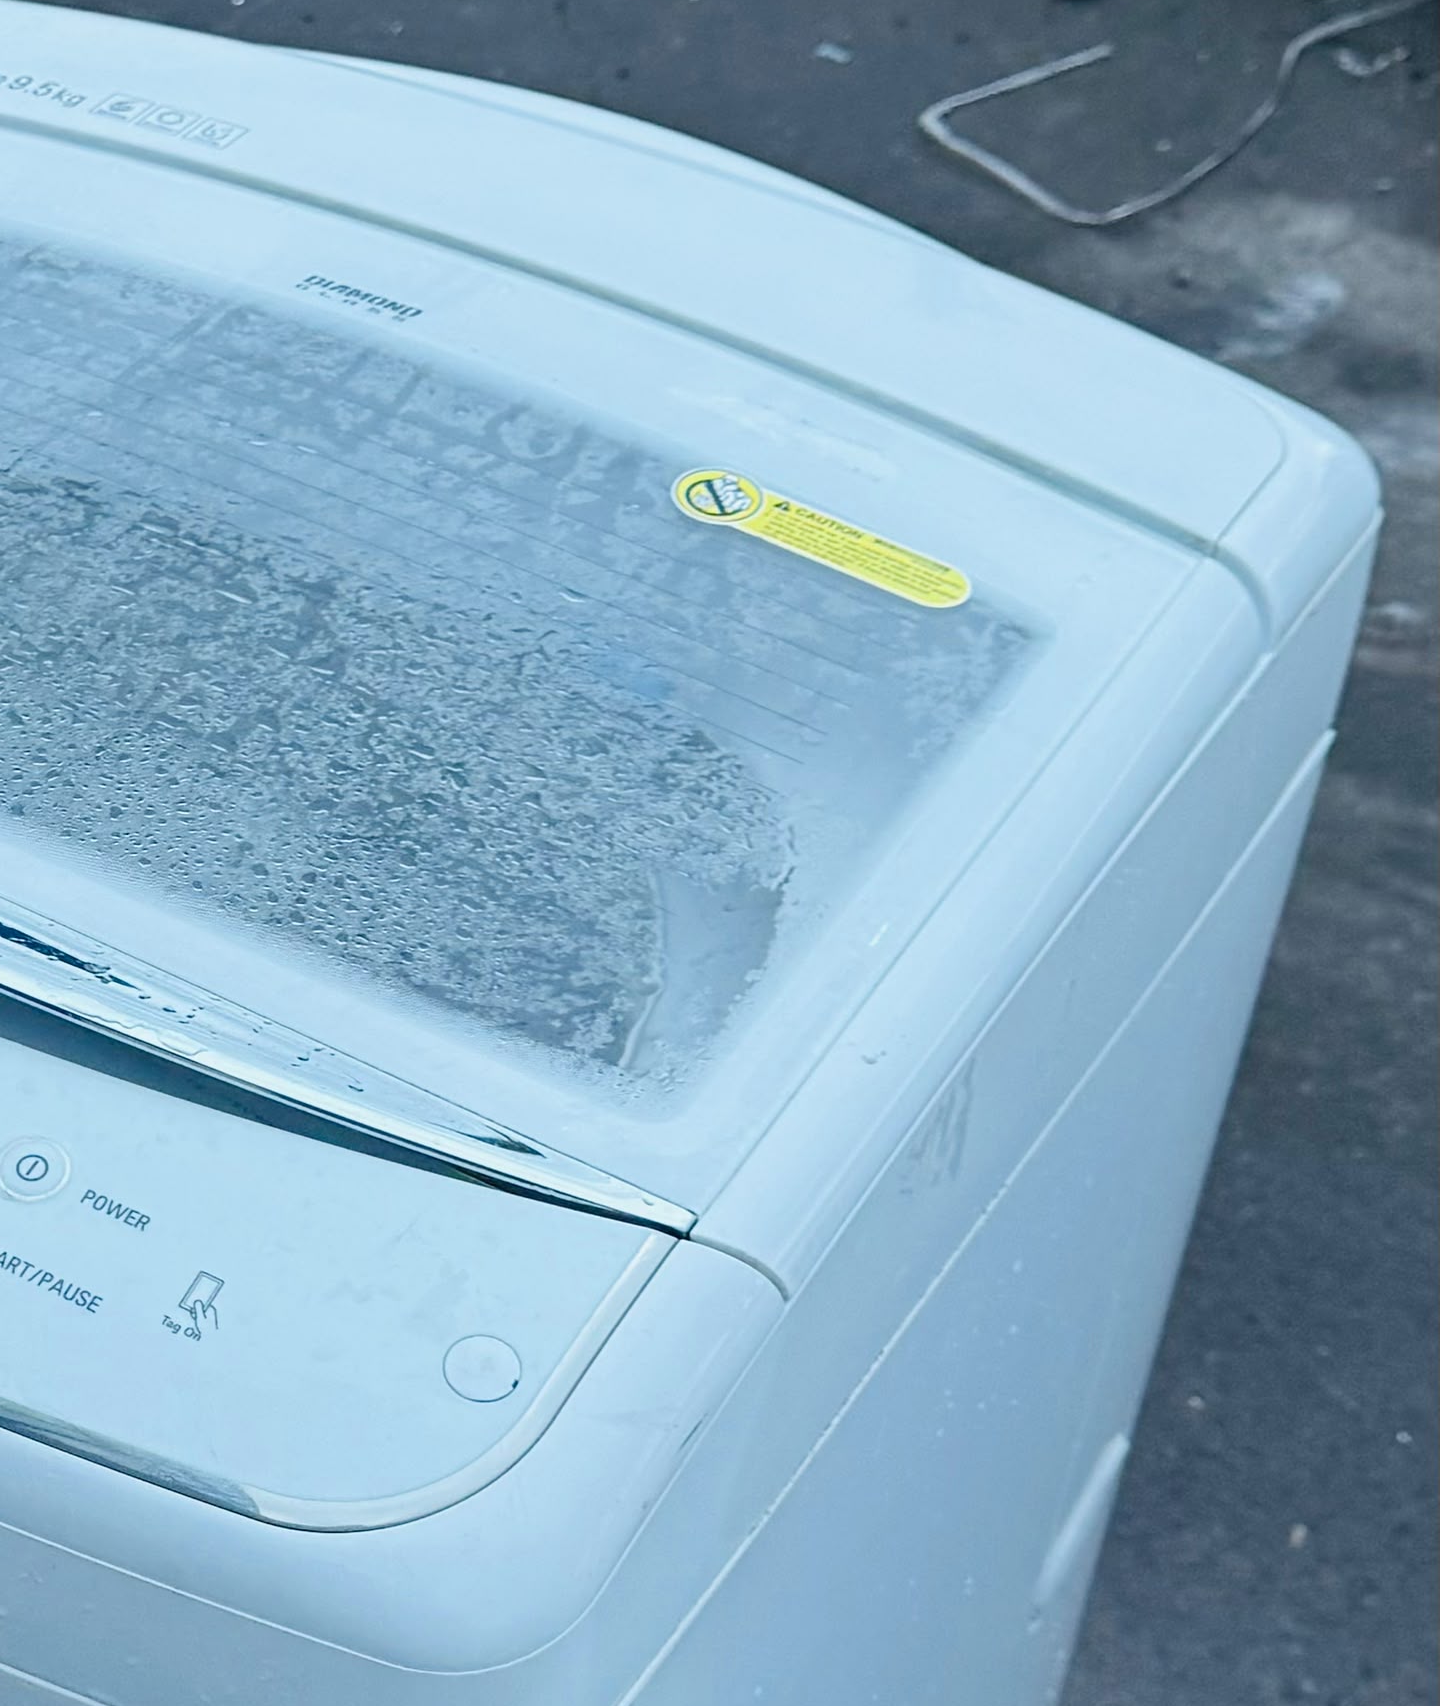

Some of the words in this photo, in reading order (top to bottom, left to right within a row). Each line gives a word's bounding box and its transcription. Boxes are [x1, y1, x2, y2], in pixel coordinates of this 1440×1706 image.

[304, 275, 423, 318] DIAMOND
[795, 508, 865, 539] CAUTION
[80, 1189, 151, 1232] POWER
[162, 1314, 181, 1334] Tag
[184, 1327, 201, 1341] On
